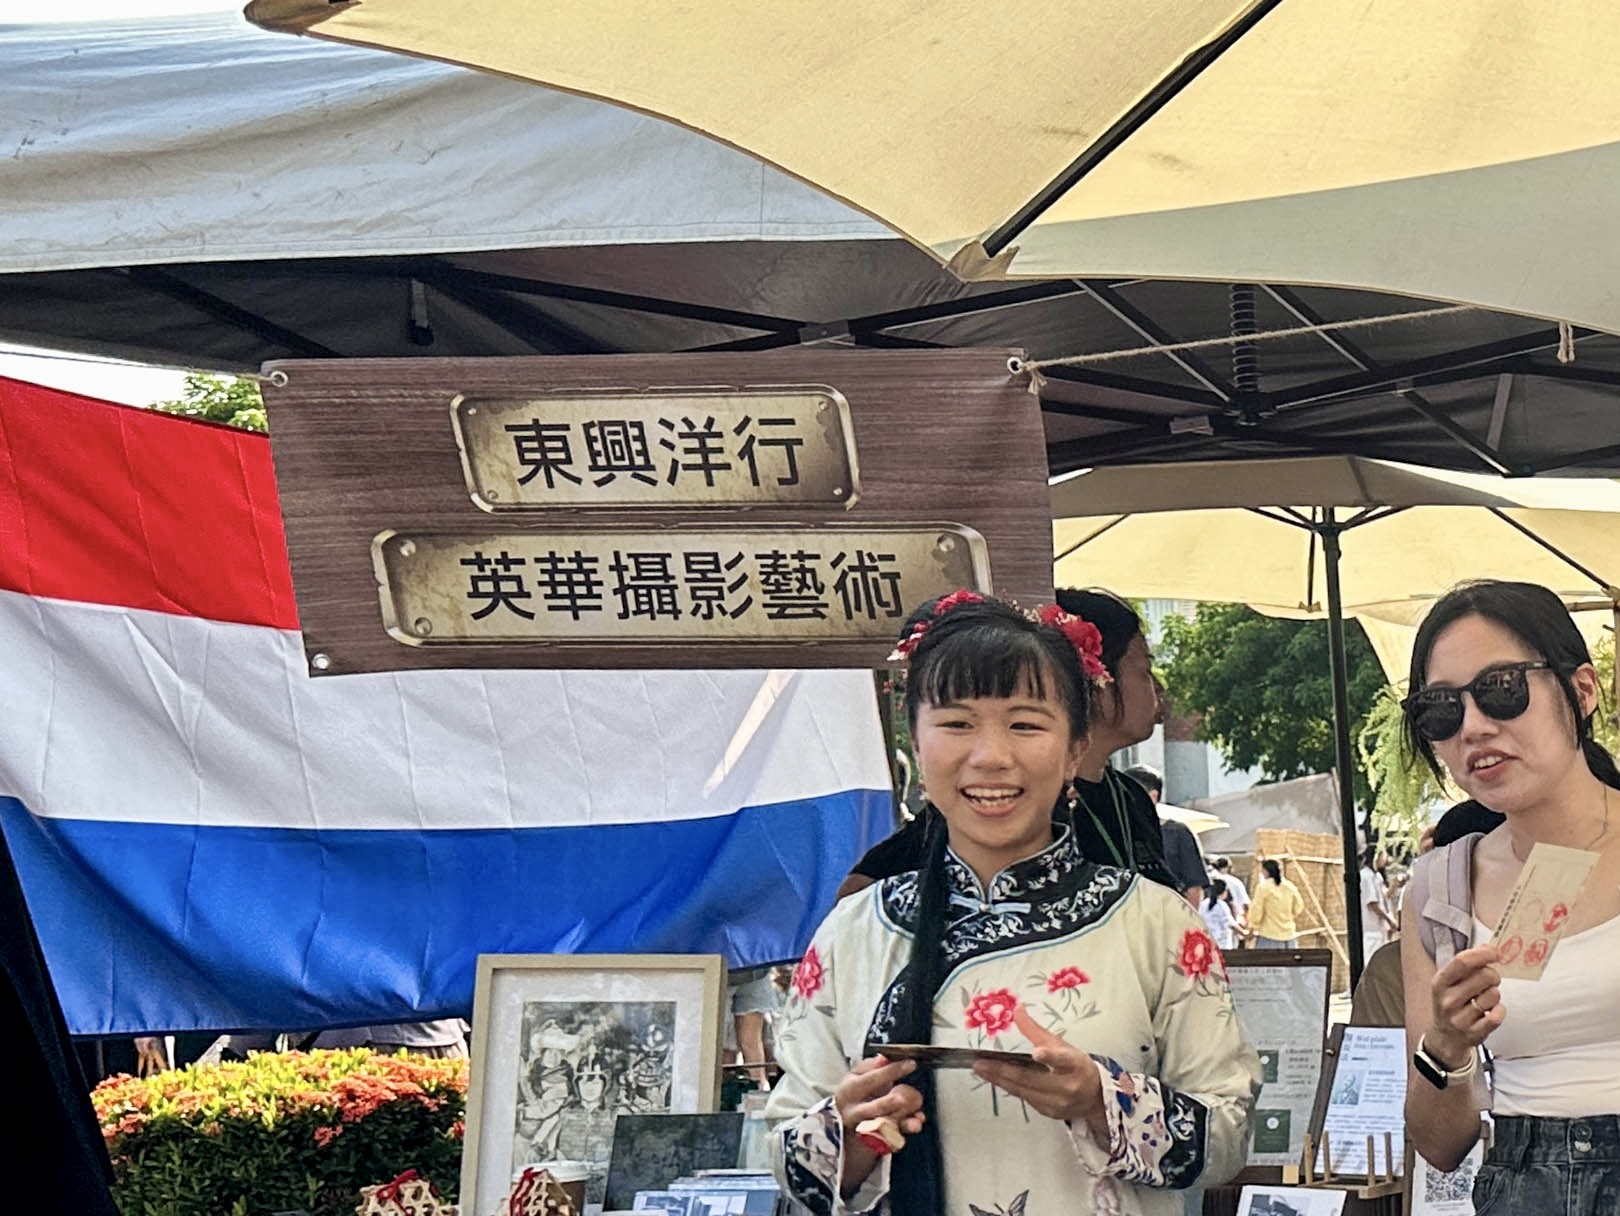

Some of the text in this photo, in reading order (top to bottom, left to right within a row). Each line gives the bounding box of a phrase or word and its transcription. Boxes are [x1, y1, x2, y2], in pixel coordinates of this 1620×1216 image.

[504, 414, 805, 489] 東興洋行
[460, 549, 904, 622] 英華攝影藝術
